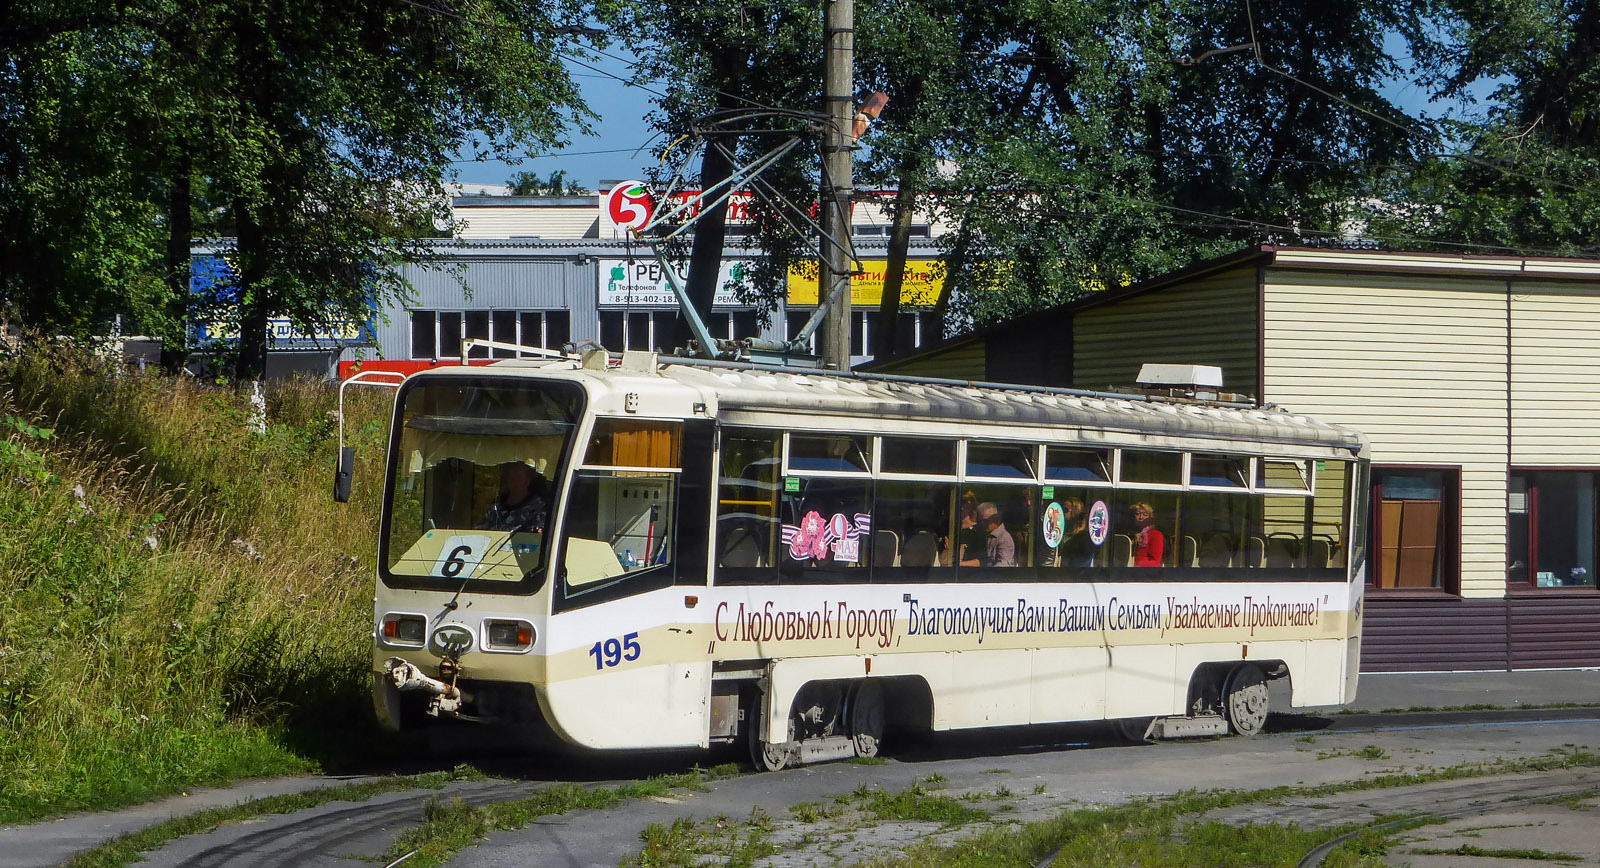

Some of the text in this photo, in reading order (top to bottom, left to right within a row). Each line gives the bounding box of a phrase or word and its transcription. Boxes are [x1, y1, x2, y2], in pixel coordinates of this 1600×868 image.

[618, 283, 657, 292] Телефонов
[441, 545, 472, 578] 6
[733, 600, 820, 642] Любовью
[821, 600, 833, 639] к
[836, 601, 901, 649] Городу,
[908, 599, 1014, 644] Благополучия
[1016, 598, 1045, 633] Вам
[1048, 606, 1056, 632] и
[1058, 598, 1105, 633] Вашим
[1165, 596, 1240, 630] Уважаемые
[589, 631, 641, 671] 195
